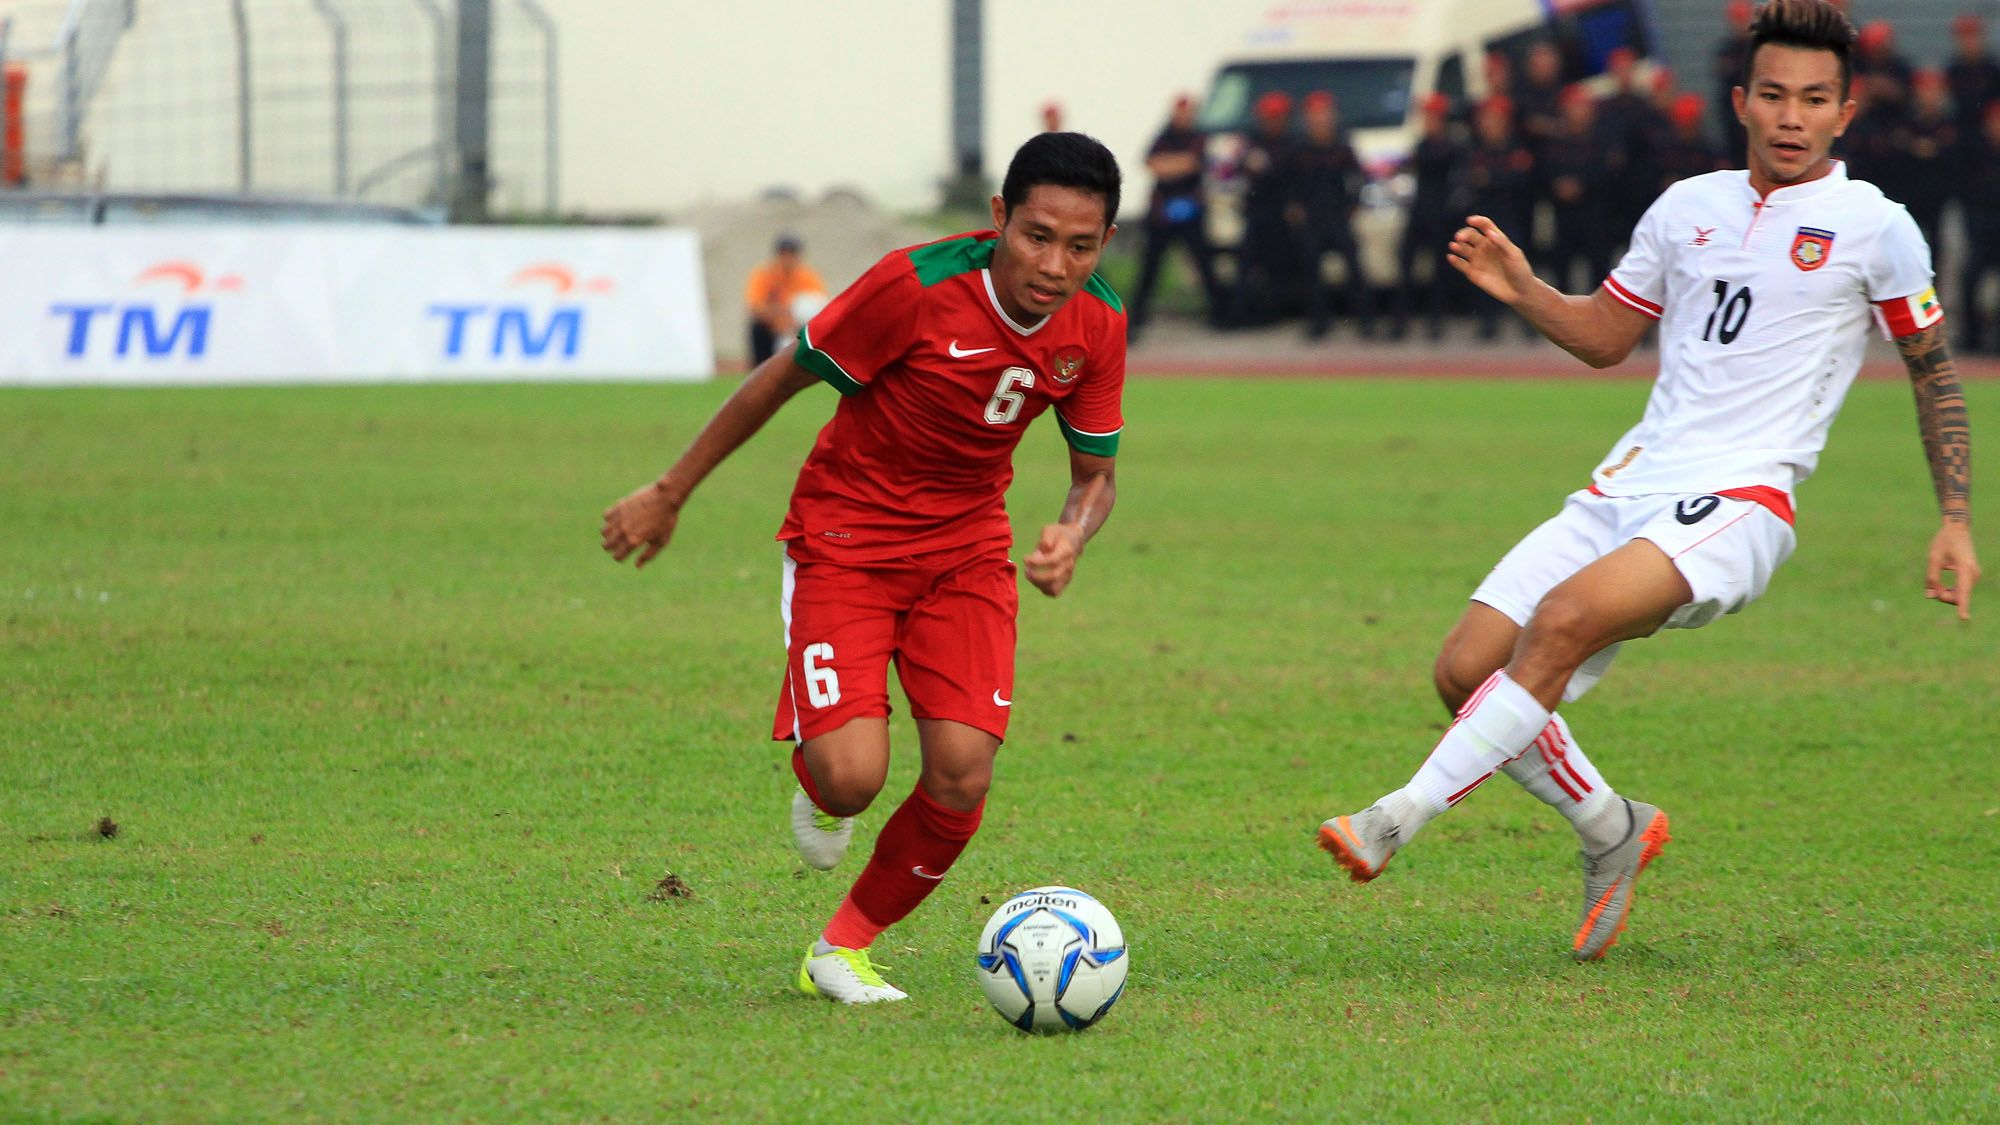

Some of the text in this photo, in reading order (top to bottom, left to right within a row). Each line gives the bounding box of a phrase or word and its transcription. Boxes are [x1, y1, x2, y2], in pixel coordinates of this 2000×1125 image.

[50, 303, 212, 357] TM
[428, 303, 582, 357] TM
[1702, 279, 1752, 345] 10
[984, 366, 1036, 425] 6
[803, 642, 841, 709] 6
[1006, 896, 1077, 915] molten
